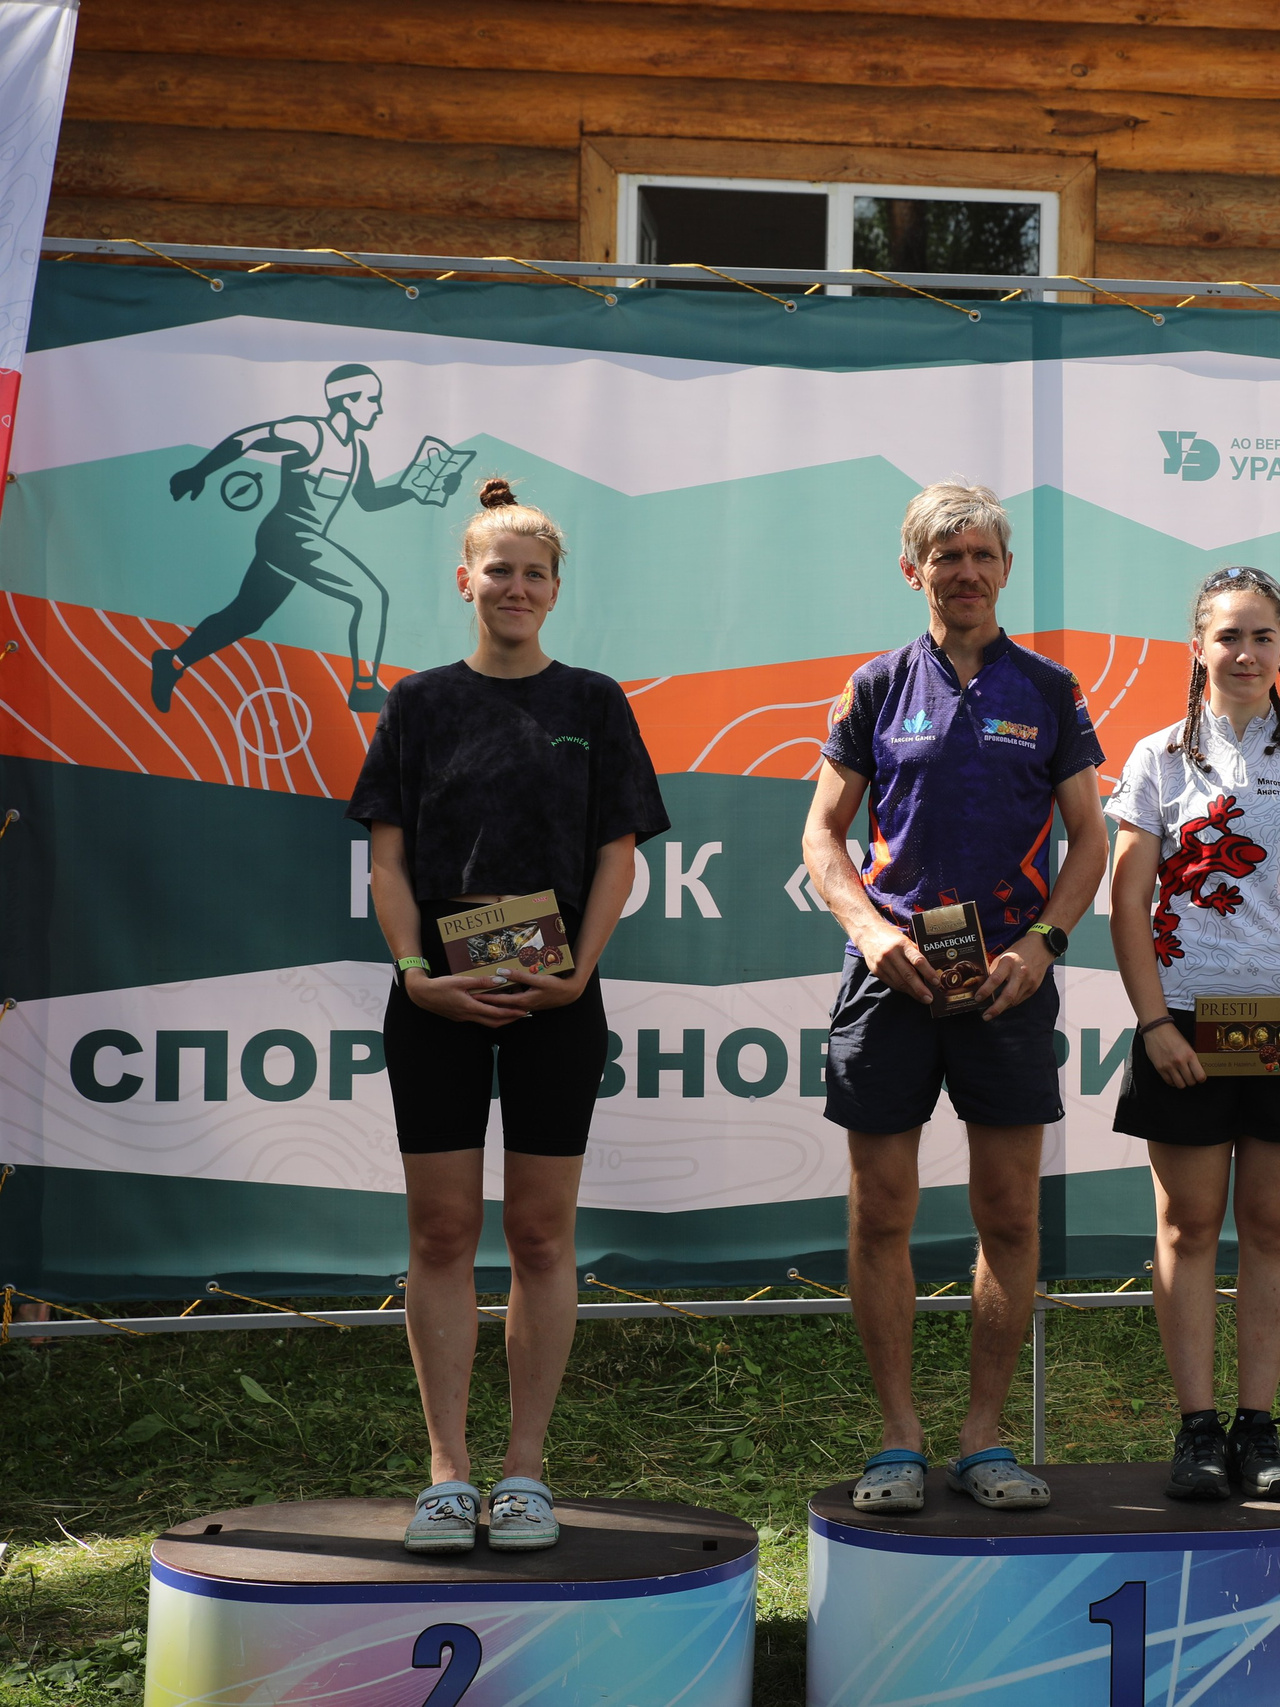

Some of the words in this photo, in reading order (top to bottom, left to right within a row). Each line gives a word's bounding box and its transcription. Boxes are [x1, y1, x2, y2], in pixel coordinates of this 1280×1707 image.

[1230, 438, 1251, 450] АО
[550, 735, 590, 751] ANYWHERE
[443, 907, 506, 935] PRESTIJ
[923, 934, 977, 952] БАБАЕВСКИЕ
[1201, 1002, 1258, 1019] PRESTIJ
[1088, 1581, 1146, 1707] 1
[412, 1622, 482, 1707] 2
